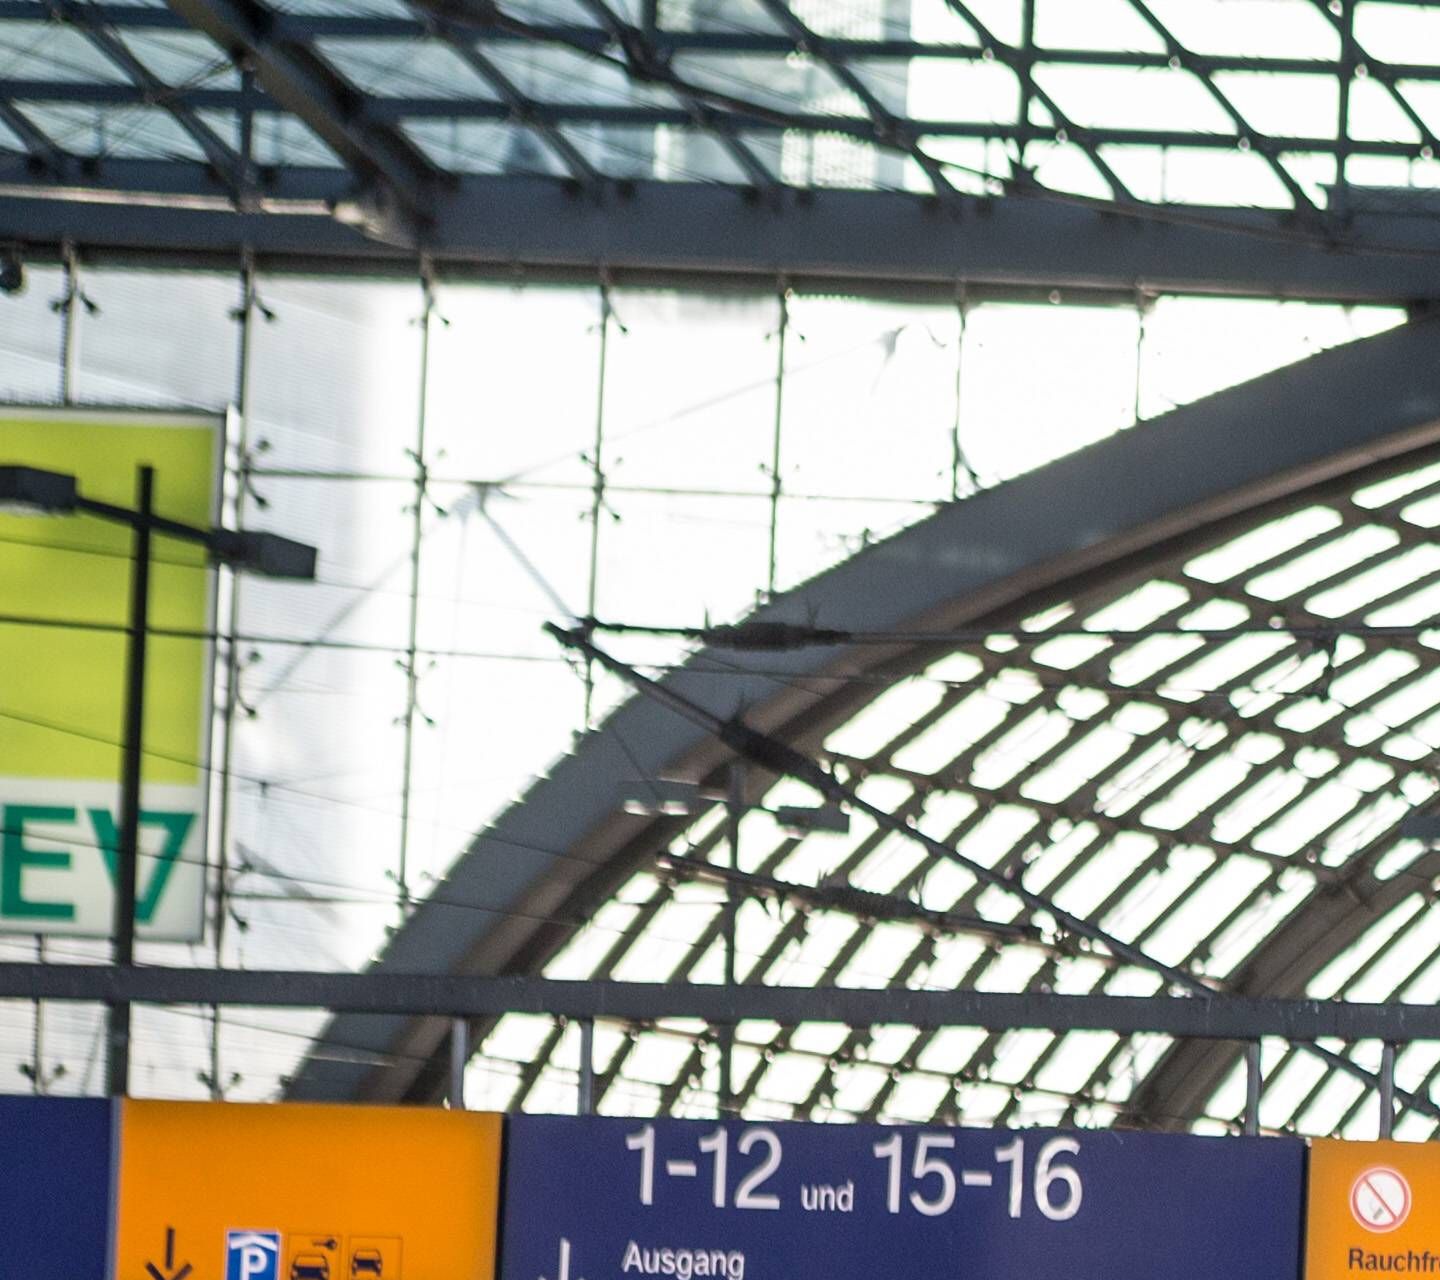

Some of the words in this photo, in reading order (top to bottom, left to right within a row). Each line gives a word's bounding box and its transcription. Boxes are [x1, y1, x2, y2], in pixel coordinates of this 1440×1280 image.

[626, 1126, 783, 1210] 1-12
[800, 1180, 855, 1213] und
[873, 1132, 1084, 1222] 15-16
